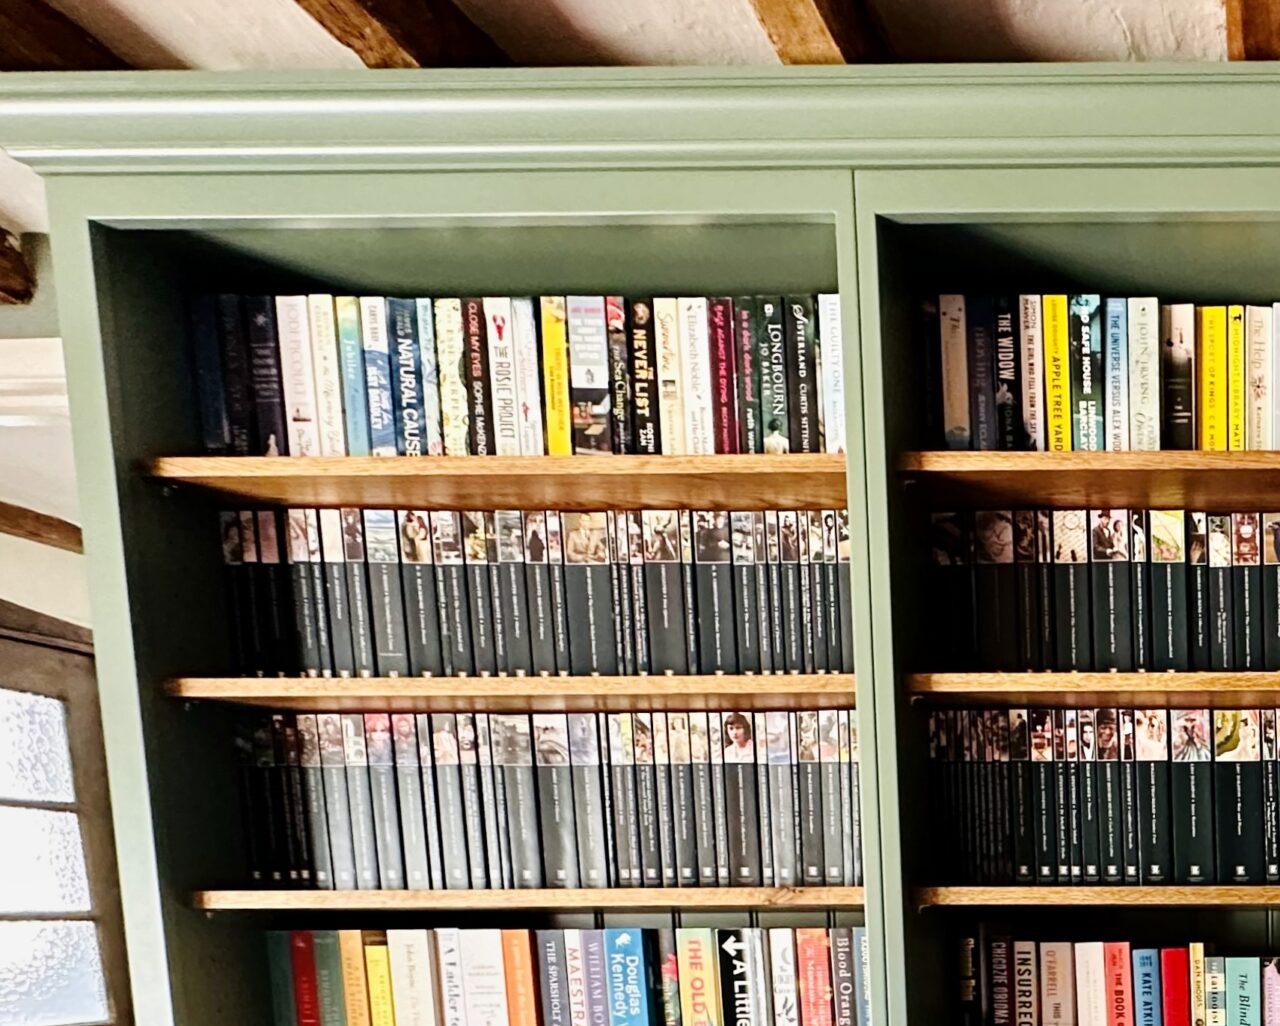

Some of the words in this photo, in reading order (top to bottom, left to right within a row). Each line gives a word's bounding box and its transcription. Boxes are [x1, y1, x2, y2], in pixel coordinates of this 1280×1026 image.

[468, 303, 480, 335] CLOSE
[998, 313, 1011, 334] THE
[1110, 315, 1119, 330] THE
[343, 339, 357, 380] Jubilee
[471, 336, 481, 351] MY
[494, 346, 509, 358] THE
[634, 329, 649, 378] NEVER
[997, 336, 1014, 380] WIDOW
[1110, 333, 1121, 372] UNIVERSE
[397, 338, 416, 407] NATURAL
[472, 353, 482, 377] EYES
[495, 361, 513, 395] ROSIE
[767, 324, 785, 415] LONGBOURN
[1051, 356, 1060, 391] APPLE
[473, 381, 485, 415] SOPHIE
[636, 383, 650, 416] LIST
[1053, 393, 1061, 420] TREE
[1111, 374, 1121, 407] VERSUS
[497, 398, 516, 439] PROJECT
[1079, 401, 1088, 450] BARCLAY
[1112, 409, 1121, 430] ALEX
[1053, 423, 1063, 451] YARD
[545, 941, 557, 964] THE
[687, 939, 703, 971] THE
[732, 959, 748, 975] A
[836, 937, 850, 977] Blood
[587, 942, 602, 999] WILLIAM
[611, 954, 631, 1018] Kennedy
[626, 956, 641, 1016] Douglas
[1142, 973, 1153, 996] KATE
[1239, 974, 1249, 991] The
[547, 965, 561, 1021] SPARSHOLT
[690, 977, 707, 1014] OLD
